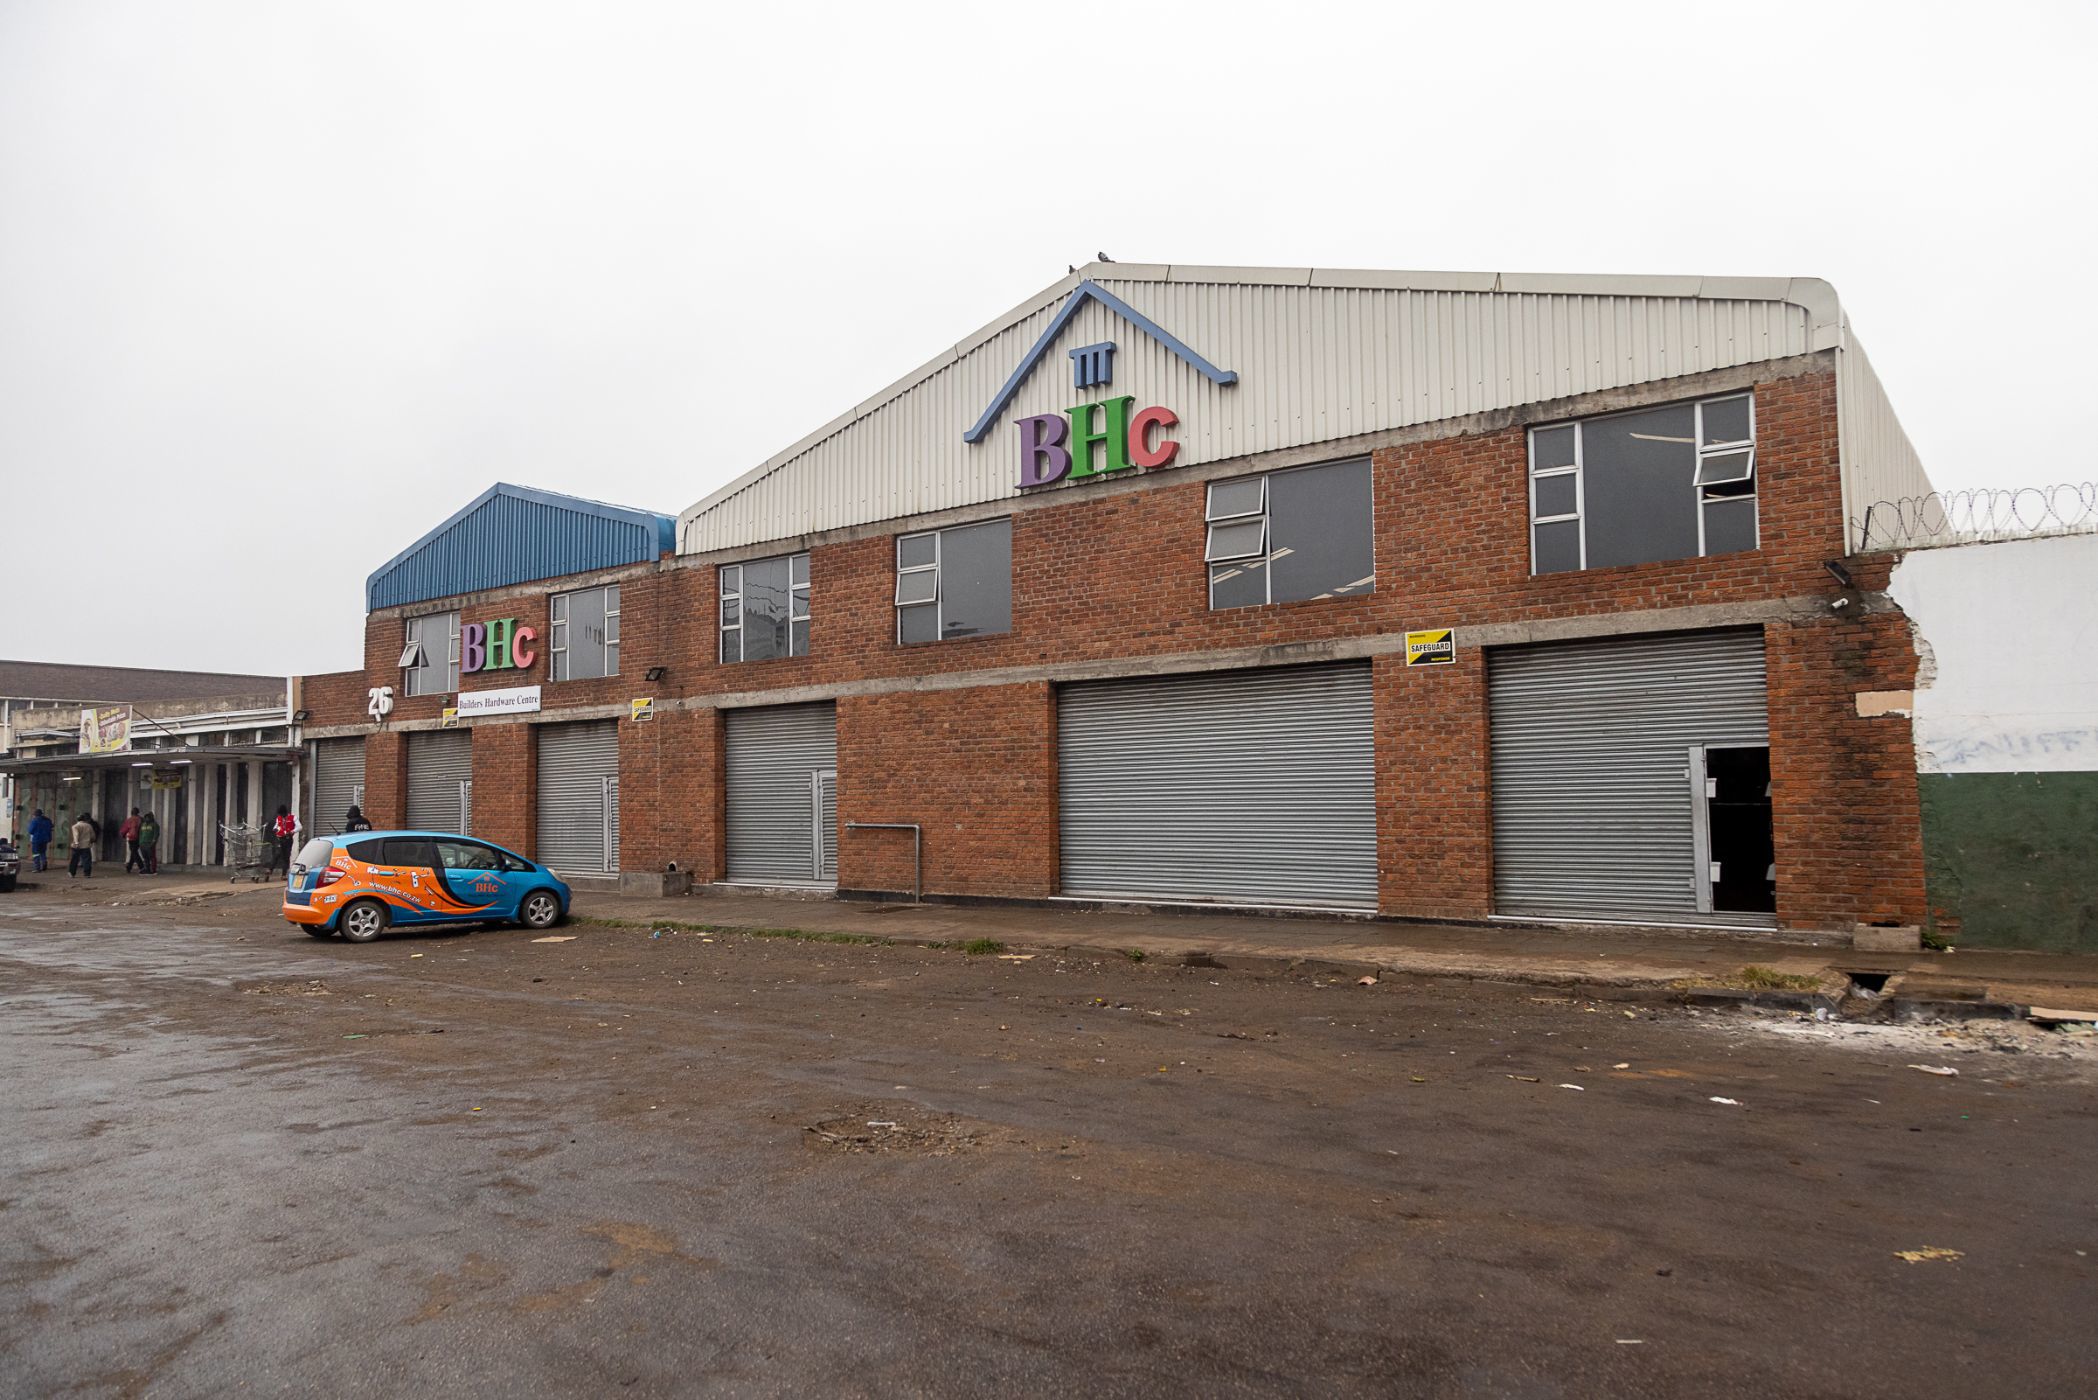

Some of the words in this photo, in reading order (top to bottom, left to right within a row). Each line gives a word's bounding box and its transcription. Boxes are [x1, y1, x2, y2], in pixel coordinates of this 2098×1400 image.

[1411, 642, 1450, 653] SAFEGUARD
[368, 686, 393, 715] 26
[459, 699, 483, 710] Builders
[484, 697, 516, 708] Hardware
[516, 694, 539, 705] Centre
[369, 881, 421, 903] www.bhc.co.zw
